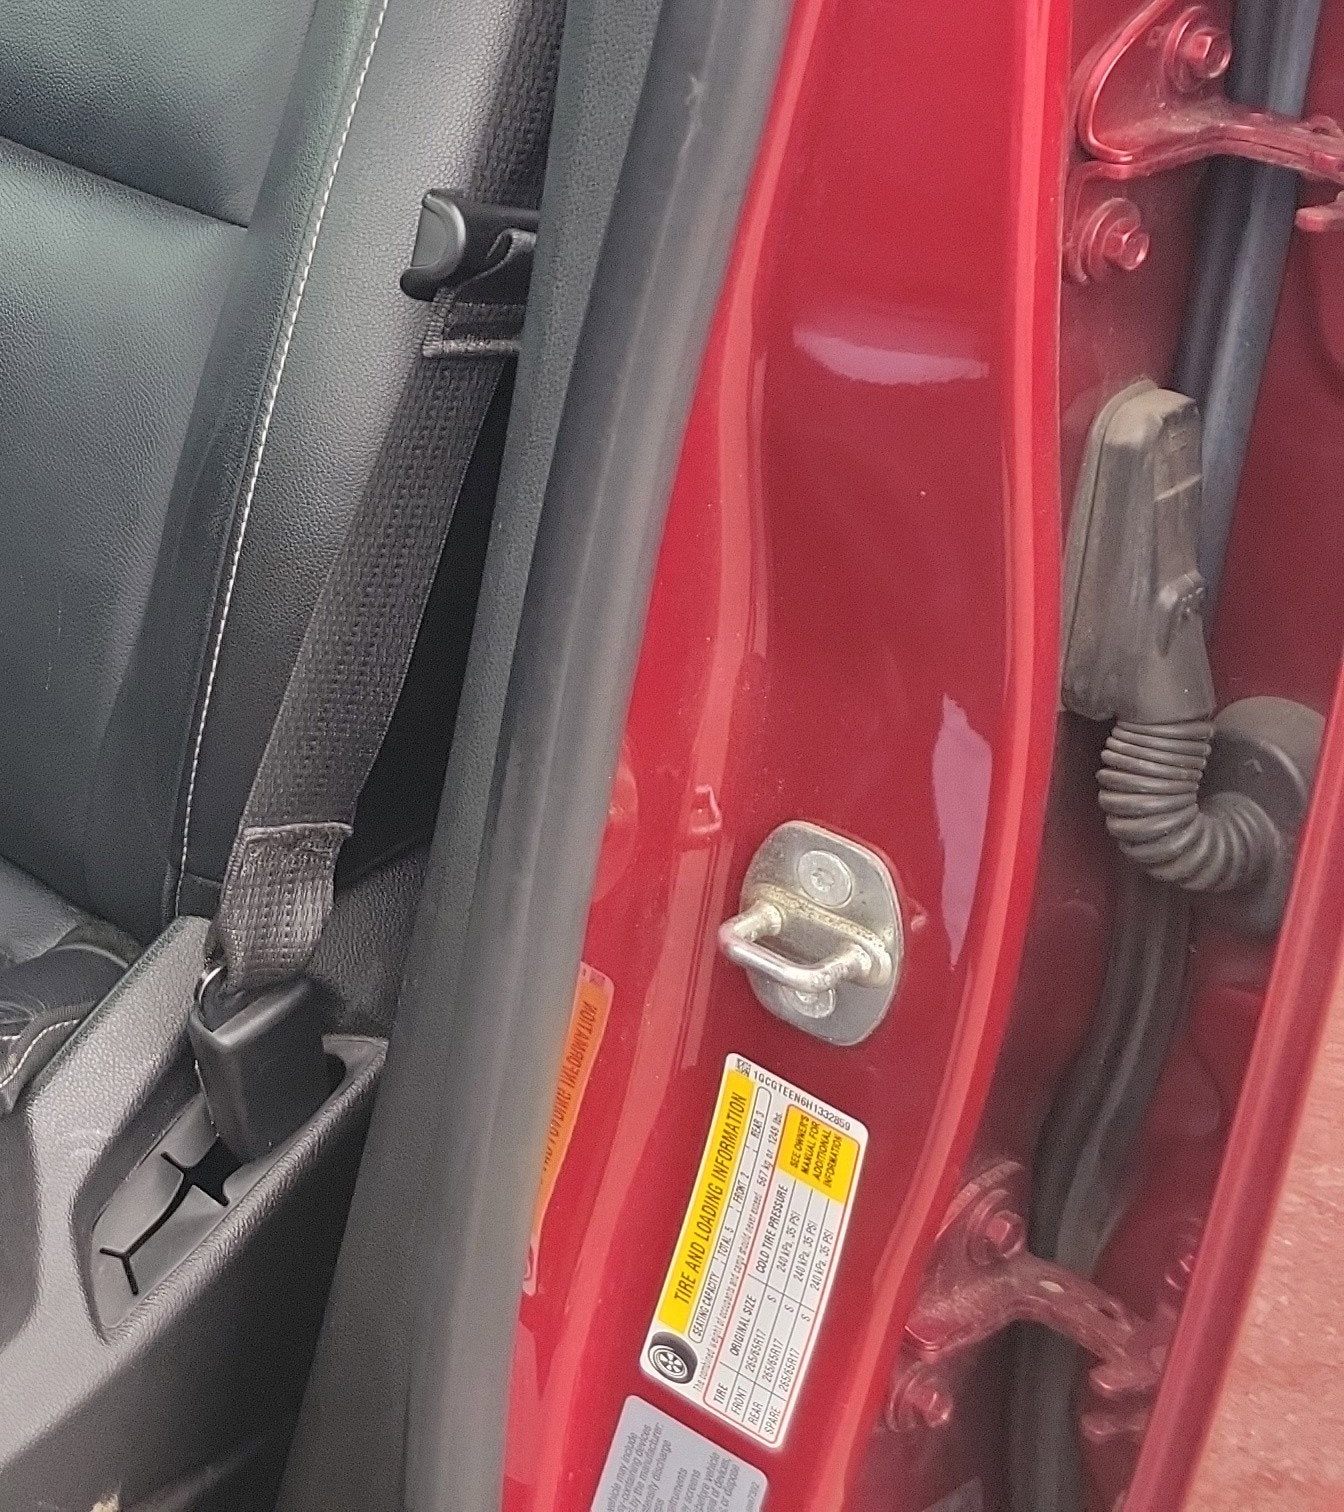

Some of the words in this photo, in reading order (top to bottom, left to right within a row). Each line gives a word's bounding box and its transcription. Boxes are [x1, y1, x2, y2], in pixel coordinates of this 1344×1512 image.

[794, 1115, 809, 1151] OWNER'S
[790, 1151, 801, 1168] SEE
[801, 1140, 816, 1174] MANUAL
[810, 1121, 820, 1139] FOR
[813, 1128, 831, 1179] ADDITIONAL
[762, 1160, 774, 1172] kg
[823, 1134, 842, 1187] INFORMATION
[675, 1272, 696, 1305] TIRE
[686, 1241, 705, 1273] AND
[696, 1182, 723, 1241] LOADING
[713, 1092, 746, 1182] INFORMATION
[768, 1184, 788, 1229] PRESSURE
[693, 1306, 709, 1336] SEATING
[702, 1272, 719, 1306] CAPACITY
[718, 1235, 731, 1256] TOTAL
[733, 1181, 746, 1203] FRONT
[751, 1120, 762, 1138] REAR
[789, 1211, 800, 1225] PSI
[806, 1220, 817, 1235] PSI
[762, 1229, 775, 1250] TIRE
[786, 1226, 796, 1238] 35
[803, 1235, 813, 1248] 35
[823, 1229, 834, 1244] PSI
[756, 1250, 769, 1273] COLD
[819, 1244, 830, 1257] 35
[777, 1256, 788, 1271] 240
[794, 1265, 805, 1281] 240
[810, 1275, 822, 1291] 240
[743, 1295, 756, 1315] SIZE
[730, 1316, 750, 1357] ORIGINAL
[746, 1329, 766, 1372] 265/65R17
[763, 1339, 783, 1382] 265/65R17
[779, 1348, 799, 1392] 265/65R17
[714, 1383, 728, 1405] TIRE
[731, 1387, 747, 1415] FRONT
[748, 1400, 762, 1425] REAR
[765, 1406, 780, 1435] SPARE
[623, 1432, 638, 1462] include
[637, 1424, 651, 1456] devices
[653, 1440, 673, 1481] discharge
[618, 1464, 629, 1482] may
[635, 1481, 645, 1496] the
